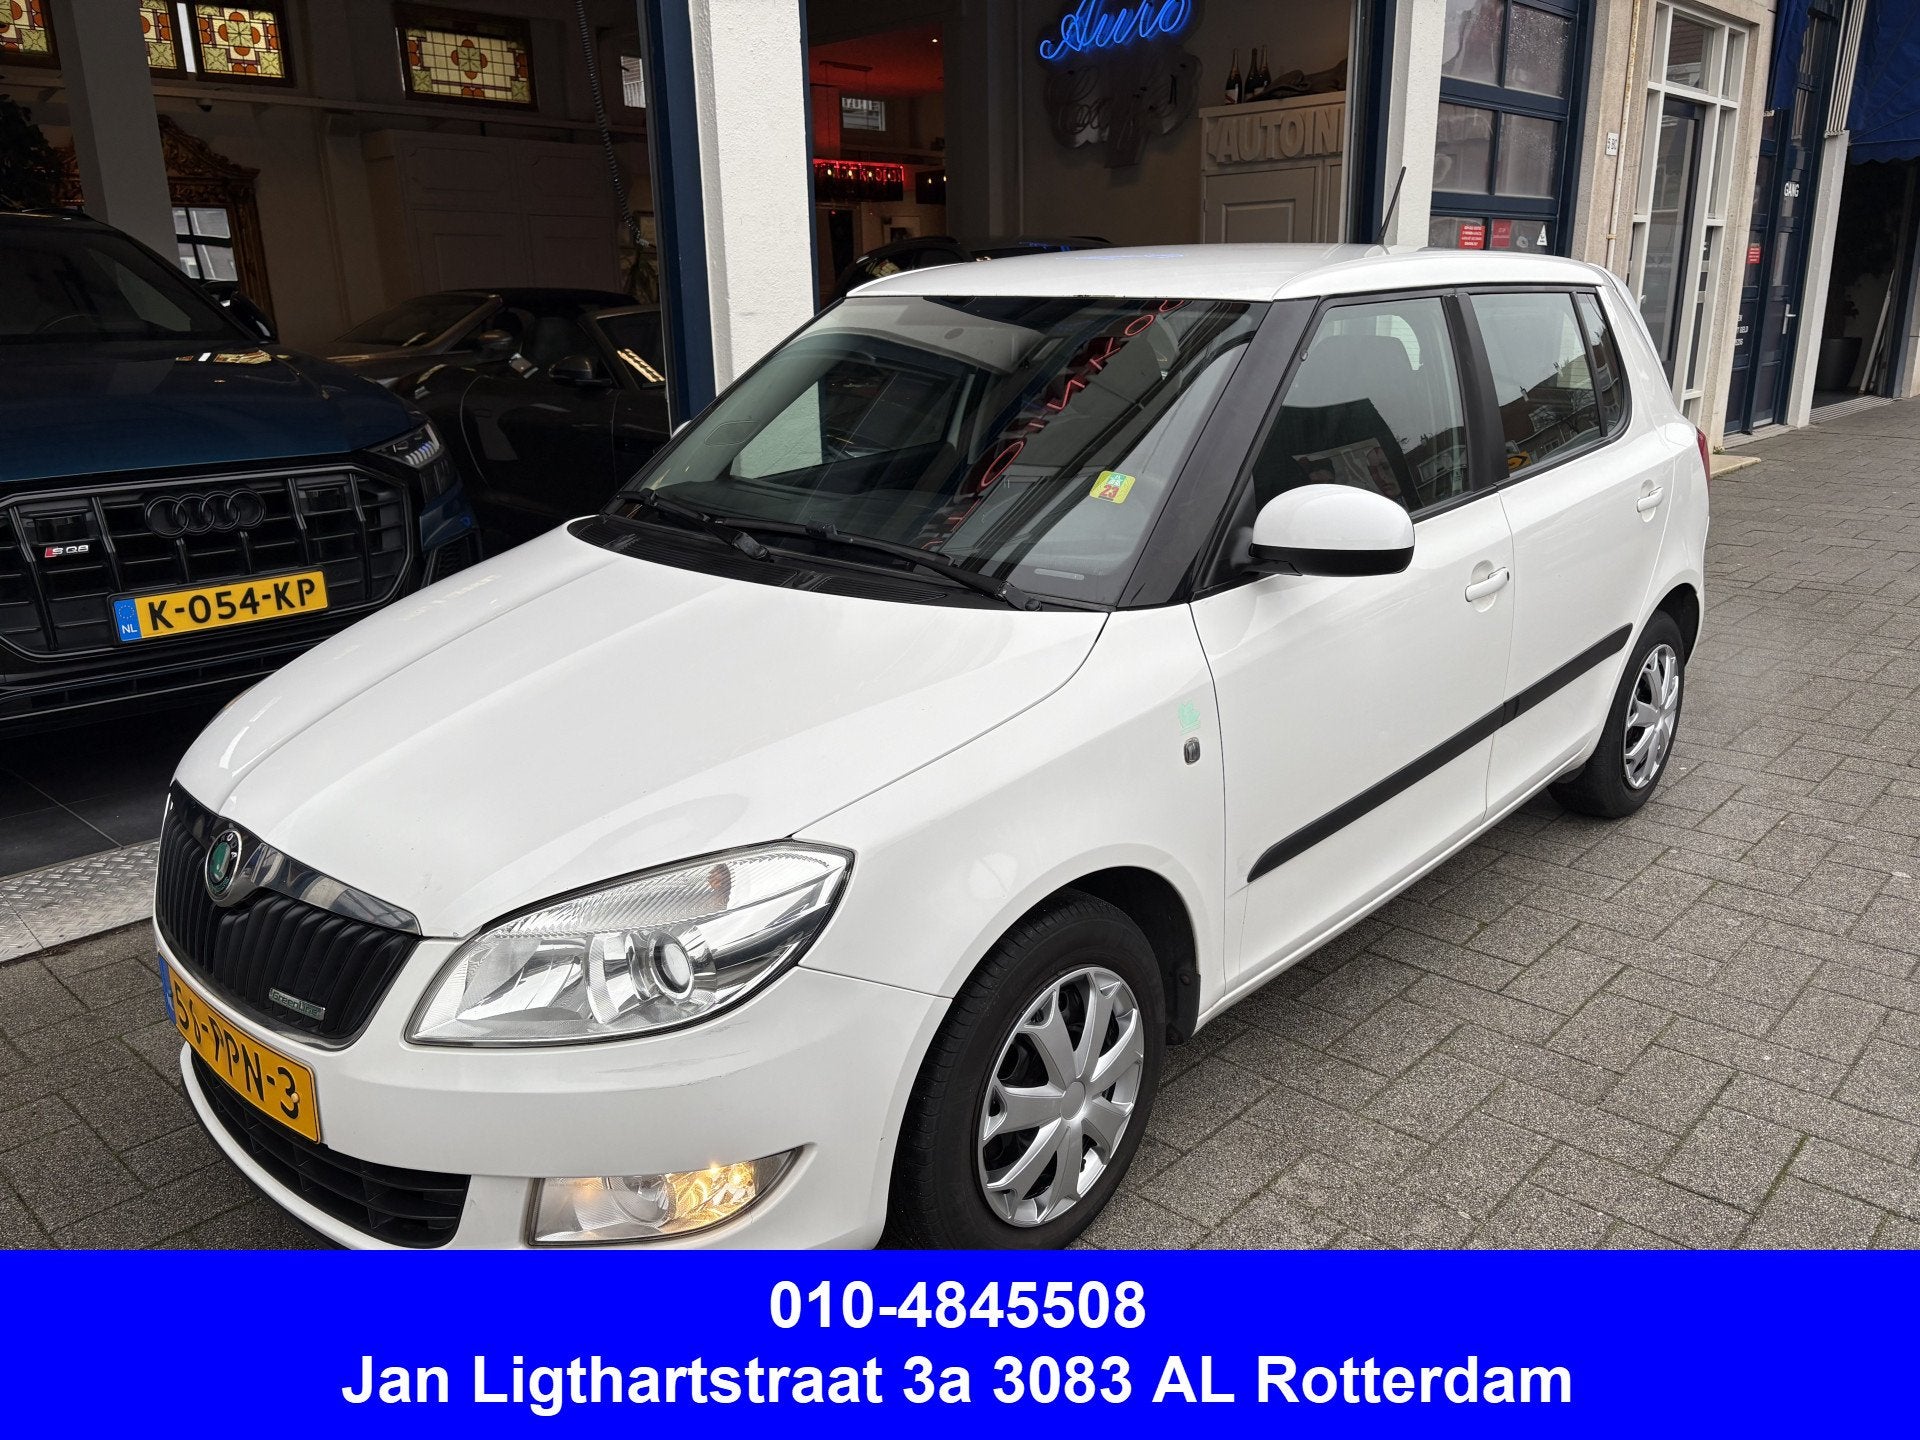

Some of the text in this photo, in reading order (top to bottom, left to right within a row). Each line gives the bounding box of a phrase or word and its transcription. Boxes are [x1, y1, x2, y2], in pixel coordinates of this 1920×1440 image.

[1100, 484, 1120, 498] 23
[121, 578, 316, 634] NL K-054-KP
